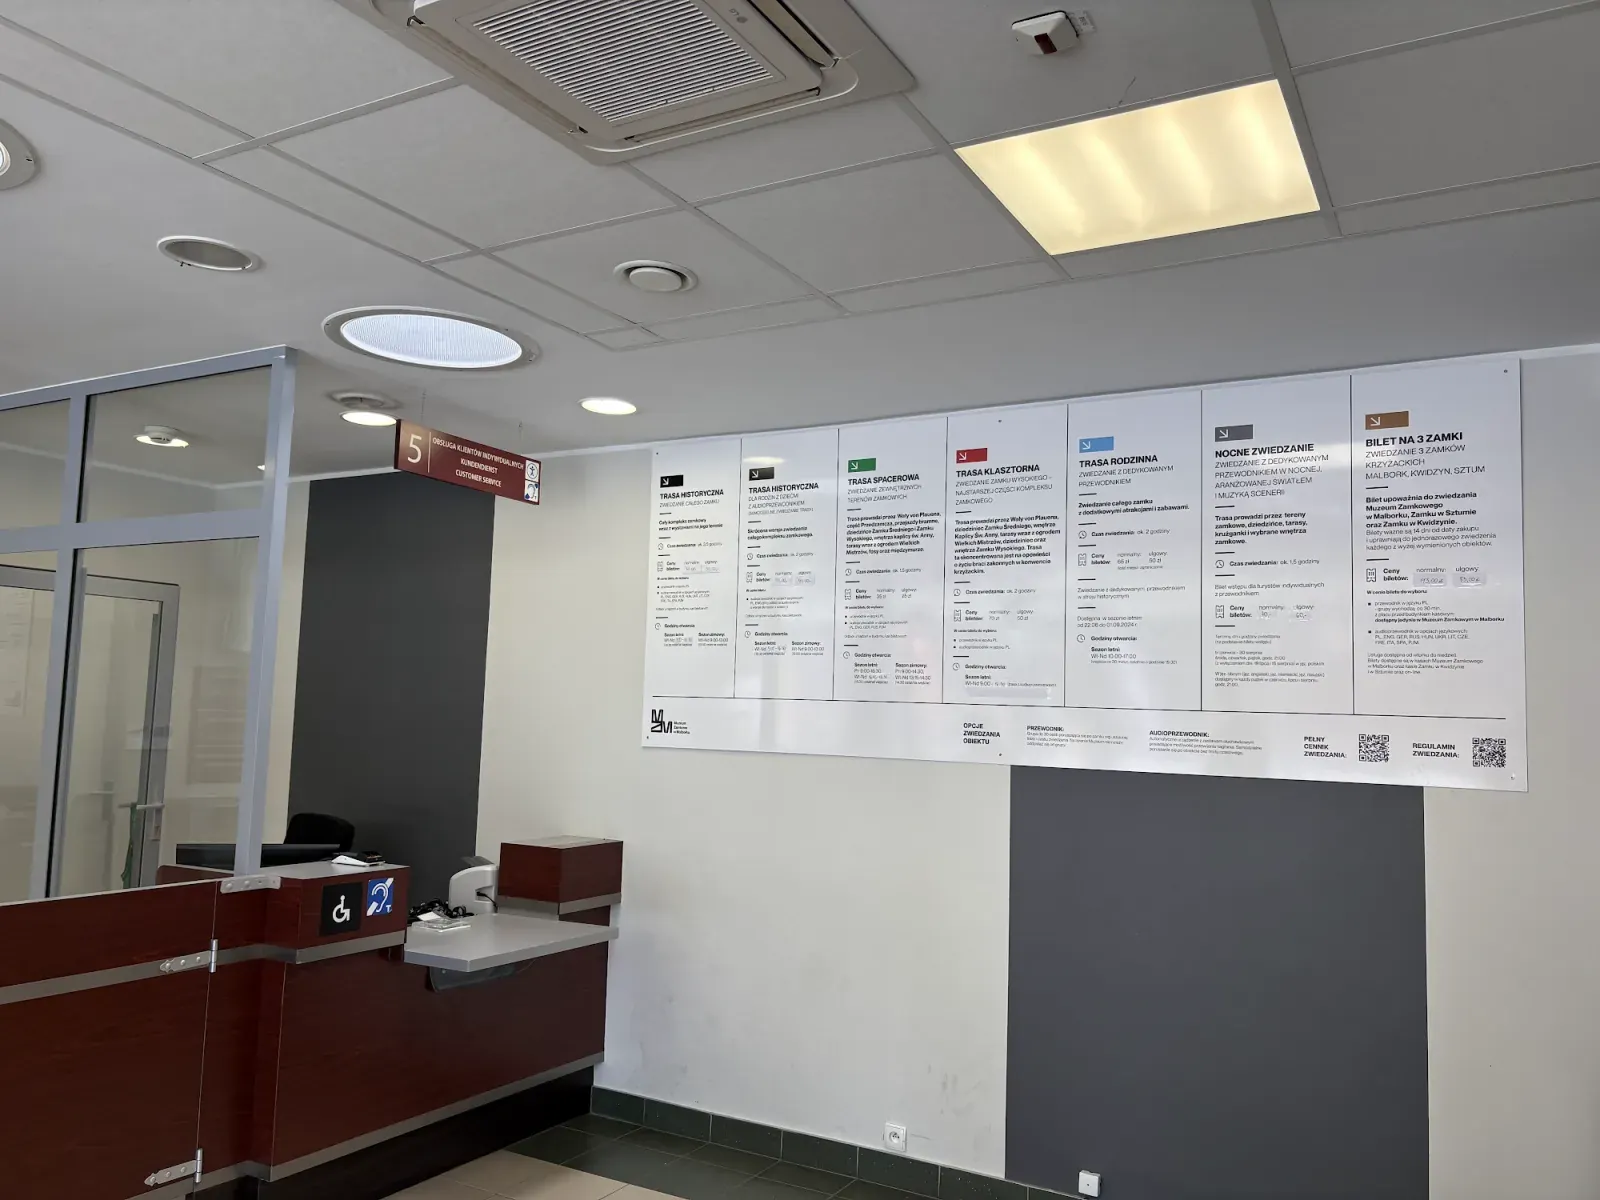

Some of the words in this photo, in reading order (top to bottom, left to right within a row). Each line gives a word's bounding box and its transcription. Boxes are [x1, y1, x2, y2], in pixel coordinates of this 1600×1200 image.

[1366, 438, 1396, 447] BILET
[1399, 436, 1414, 445] NA
[1426, 432, 1463, 442] ZAMKI
[408, 434, 422, 463] 5
[1215, 449, 1249, 458] NOCNE
[1252, 444, 1314, 455] ZWIEDZANIE
[1366, 448, 1416, 458] ZWIEDZANIE
[1425, 444, 1465, 454] ZAMKÓW
[432, 438, 456, 450] OBSŁUGA
[457, 444, 482, 457] KLIENTÓW
[482, 452, 524, 470] INDYWIDUALNYCH
[461, 458, 498, 474] KUNDENDIENST
[1079, 459, 1109, 468] TRASA
[1111, 455, 1158, 466] RODZINNA
[1215, 460, 1259, 468] ZWIEDZANIE
[1268, 455, 1328, 464] DEDYKOWANYM
[1366, 459, 1425, 468] KRZYŻACKICH
[985, 464, 1040, 475] KLASZTORNA
[1123, 465, 1174, 474] DEDYKOWANYM
[1215, 469, 1277, 478] PRZEWODNIKIEM
[1366, 471, 1409, 480] MALBORK,
[1411, 468, 1452, 477] KWIDZYN,
[1454, 466, 1485, 474] SZTUM
[456, 469, 482, 482] CUSTOMER
[483, 477, 501, 487] SERVICE
[873, 474, 919, 484] SPACEROWA
[956, 479, 989, 487] ZWIEDZANIE
[1011, 475, 1047, 483] WYSOKIEGO
[1079, 479, 1131, 487] PRZEWODNIKIEM
[1215, 480, 1271, 488] ARANŻOWANEJ
[1273, 477, 1312, 485] ŚWIATŁEM
[772, 483, 819, 492] HISTORYCZNA
[681, 489, 723, 498] HISTORYCZNA
[1218, 491, 1249, 499] MUZYKĄ
[1251, 489, 1285, 497] SCENERII
[1384, 494, 1422, 503] upoważnia
[1398, 502, 1443, 510] Zamkowego
[1234, 513, 1263, 521] prowadzi
[1446, 508, 1476, 516] Sztumie
[1149, 730, 1209, 738] AUDIOPRZEWODNIK:
